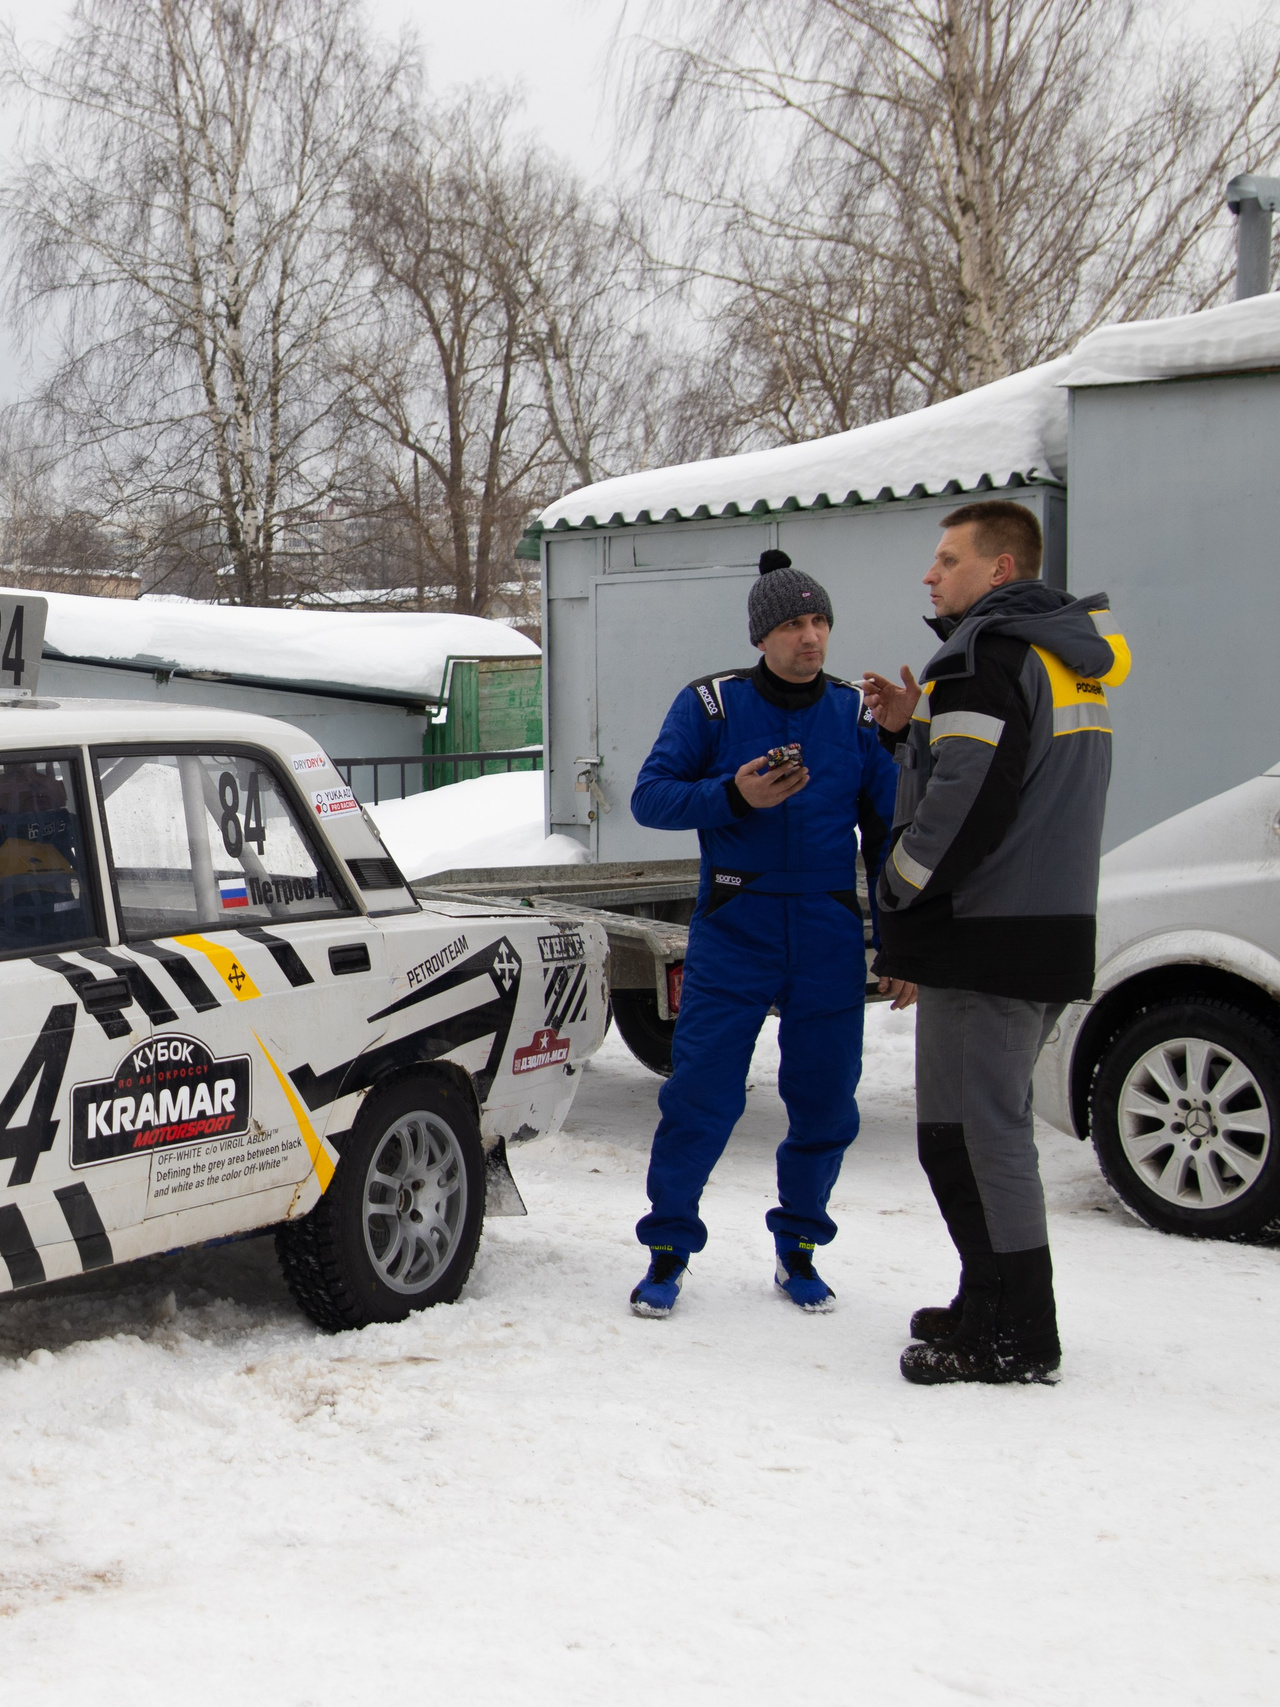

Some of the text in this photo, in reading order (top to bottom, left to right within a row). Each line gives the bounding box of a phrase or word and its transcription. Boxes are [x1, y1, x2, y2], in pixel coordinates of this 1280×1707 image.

[696, 685, 718, 715] sparco
[293, 757, 320, 770] DRYDRY
[325, 790, 344, 801] YUKA
[331, 803, 340, 811] PRO
[218, 771, 267, 858] 84
[249, 877, 315, 905] Петров
[715, 874, 742, 885] sparco
[407, 934, 469, 988] PETROVTEAM
[133, 1041, 194, 1073] КУБОК
[118, 1065, 208, 1089] ПО АВОКРОССУ
[87, 1078, 236, 1139] KRAMAR
[132, 1115, 236, 1148] MOTORSPORT
[156, 1137, 303, 1182] Defining the grey area between black
[158, 1147, 202, 1165] OFF-WHITE
[205, 1145, 218, 1156] c/o
[219, 1138, 245, 1151] VIRGIL
[154, 1185, 169, 1198] and
[171, 1181, 193, 1194] white
[195, 1178, 205, 1188] as
[206, 1174, 220, 1186] the
[221, 1168, 242, 1182] color
